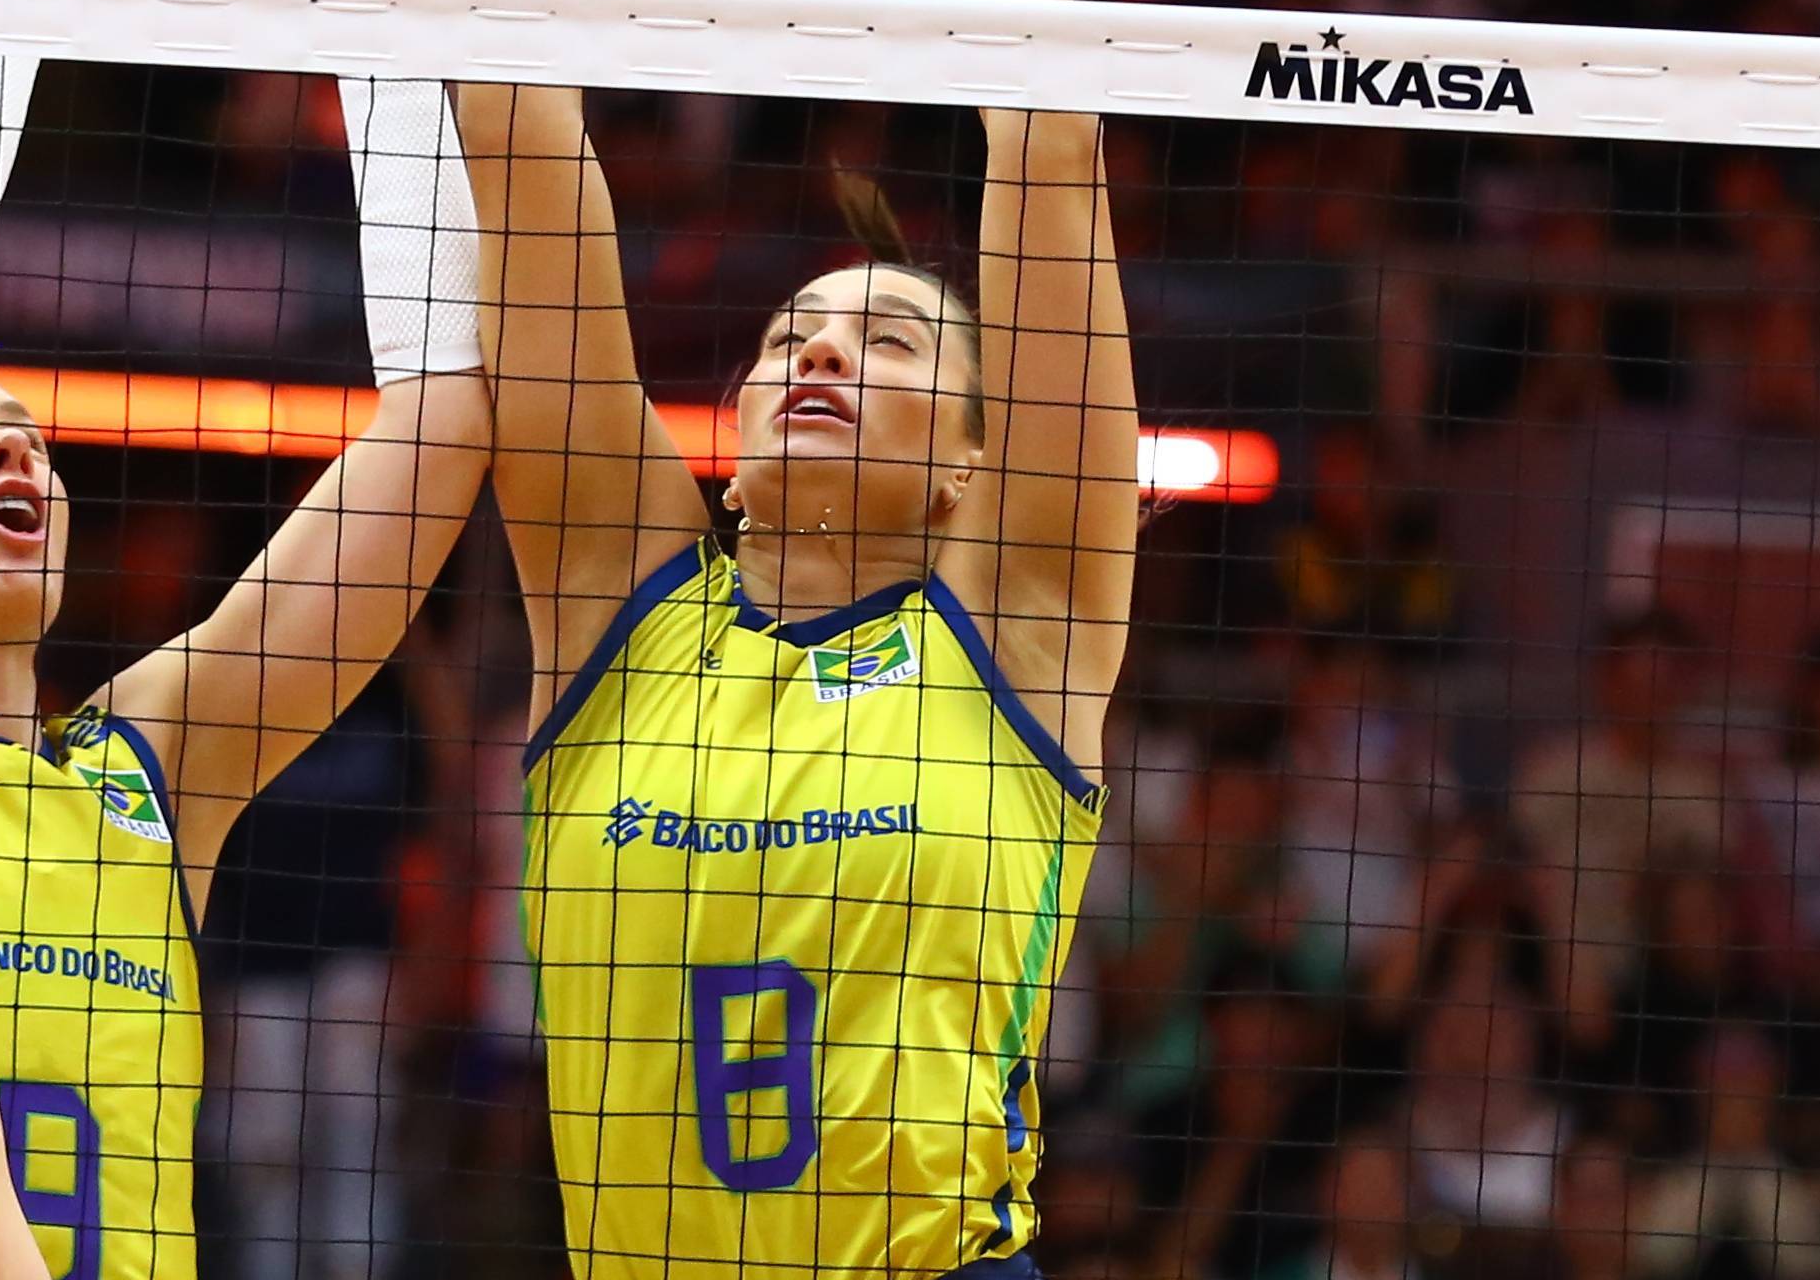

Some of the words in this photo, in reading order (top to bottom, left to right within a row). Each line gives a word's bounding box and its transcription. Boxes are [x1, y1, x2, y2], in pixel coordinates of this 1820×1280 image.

[1244, 26, 1534, 115] MIKASA
[803, 803, 923, 844] BRASIL
[62, 947, 101, 981] DO
[691, 957, 819, 1193] 8
